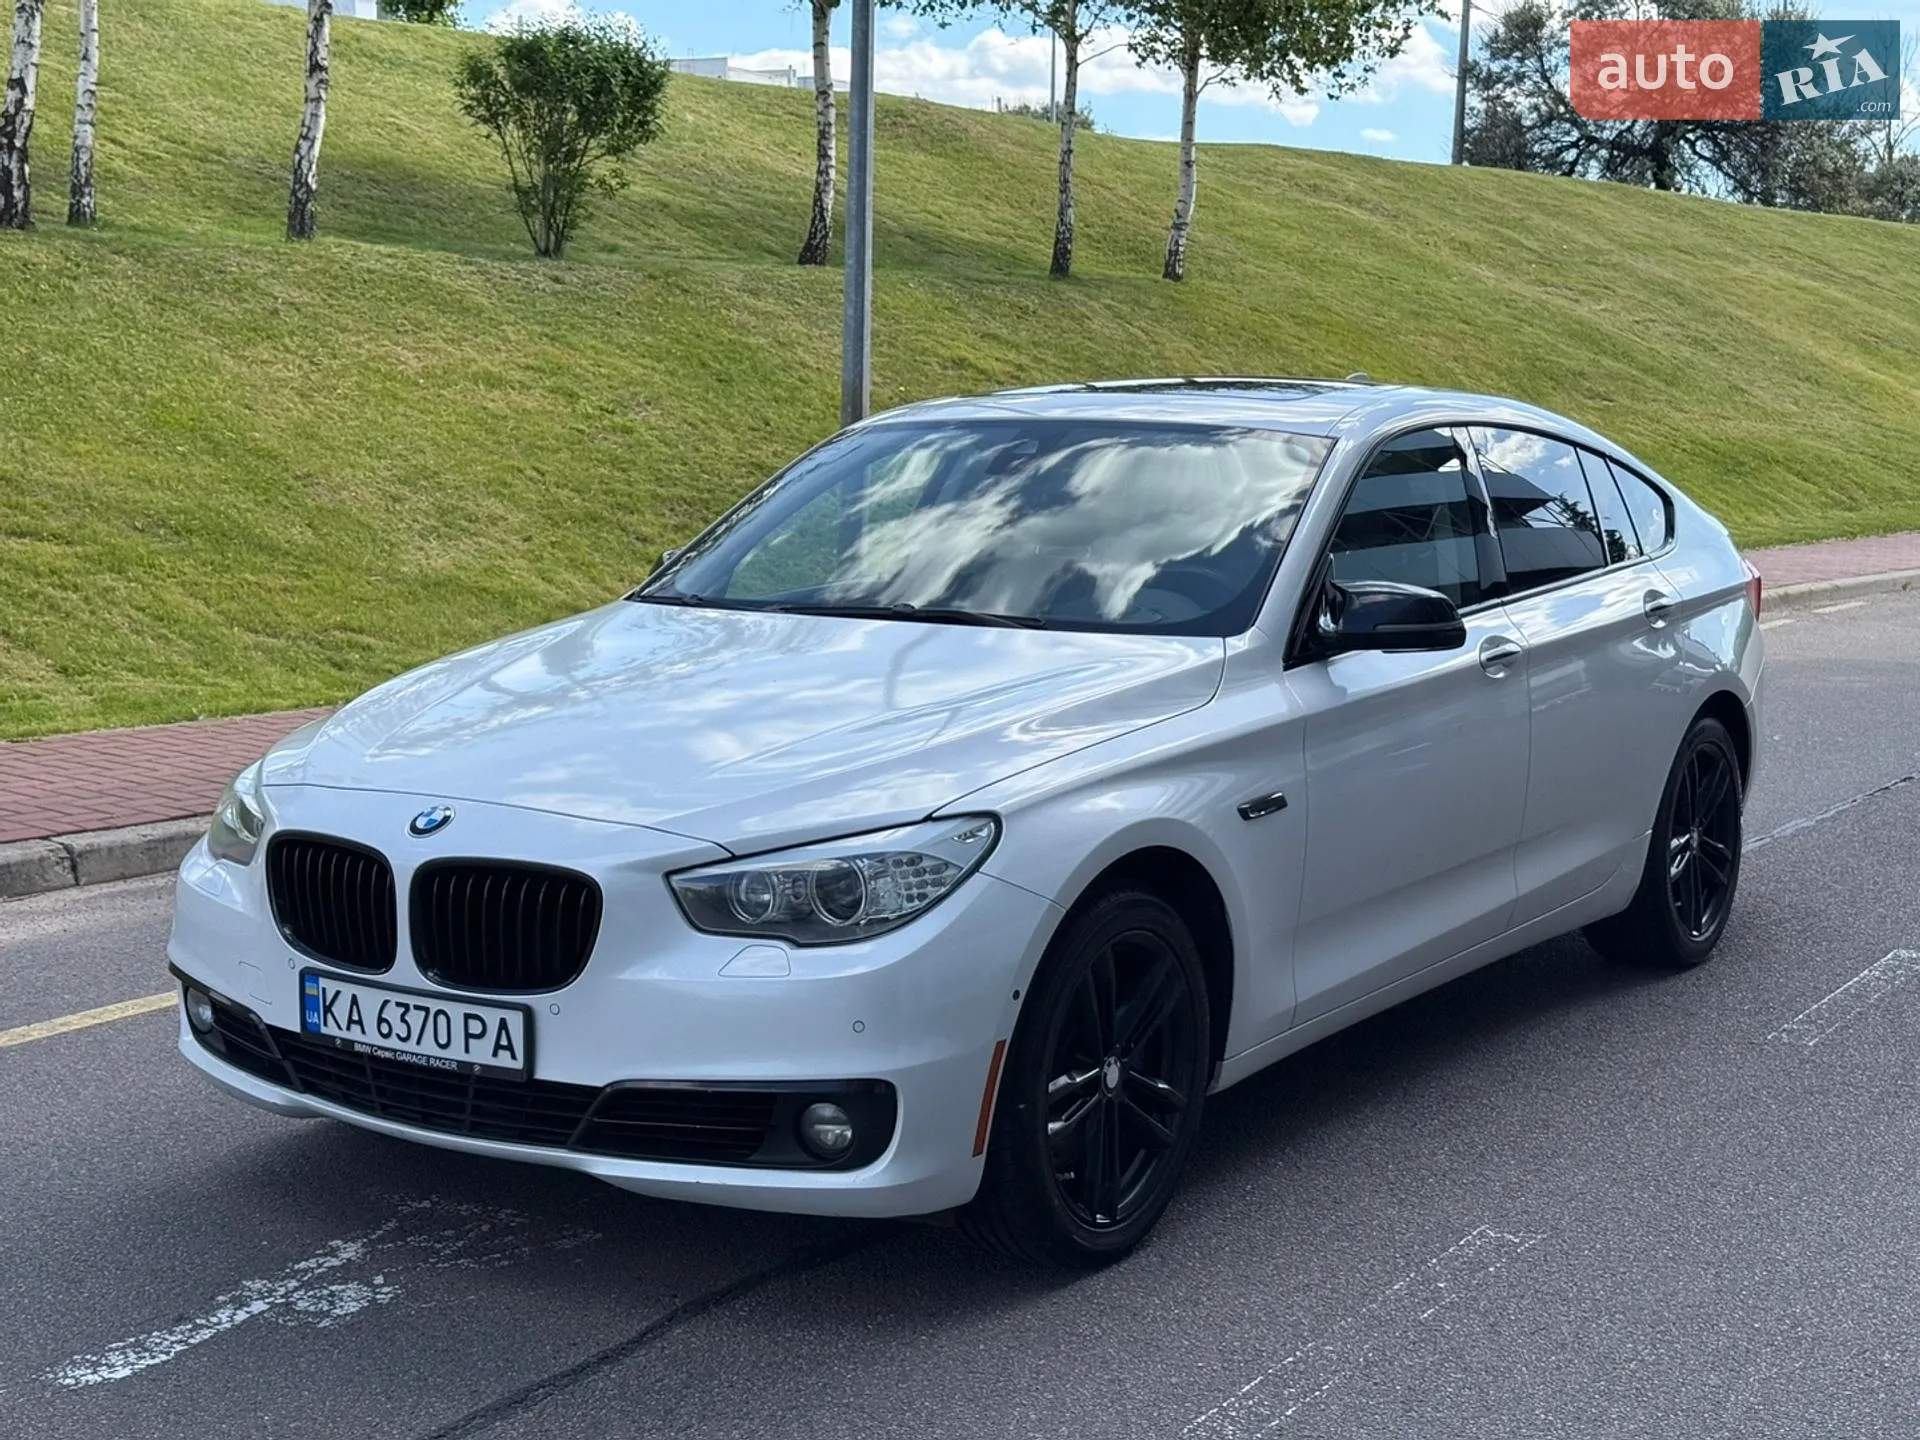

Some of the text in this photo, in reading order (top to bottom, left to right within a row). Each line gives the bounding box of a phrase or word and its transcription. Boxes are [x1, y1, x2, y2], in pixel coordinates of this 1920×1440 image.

[305, 1009, 320, 1025] UA
[321, 986, 518, 1061] KA 6370 PA
[353, 1042, 372, 1054] BMW
[395, 1051, 428, 1066] GARAGE
[429, 1057, 458, 1070] RACER
